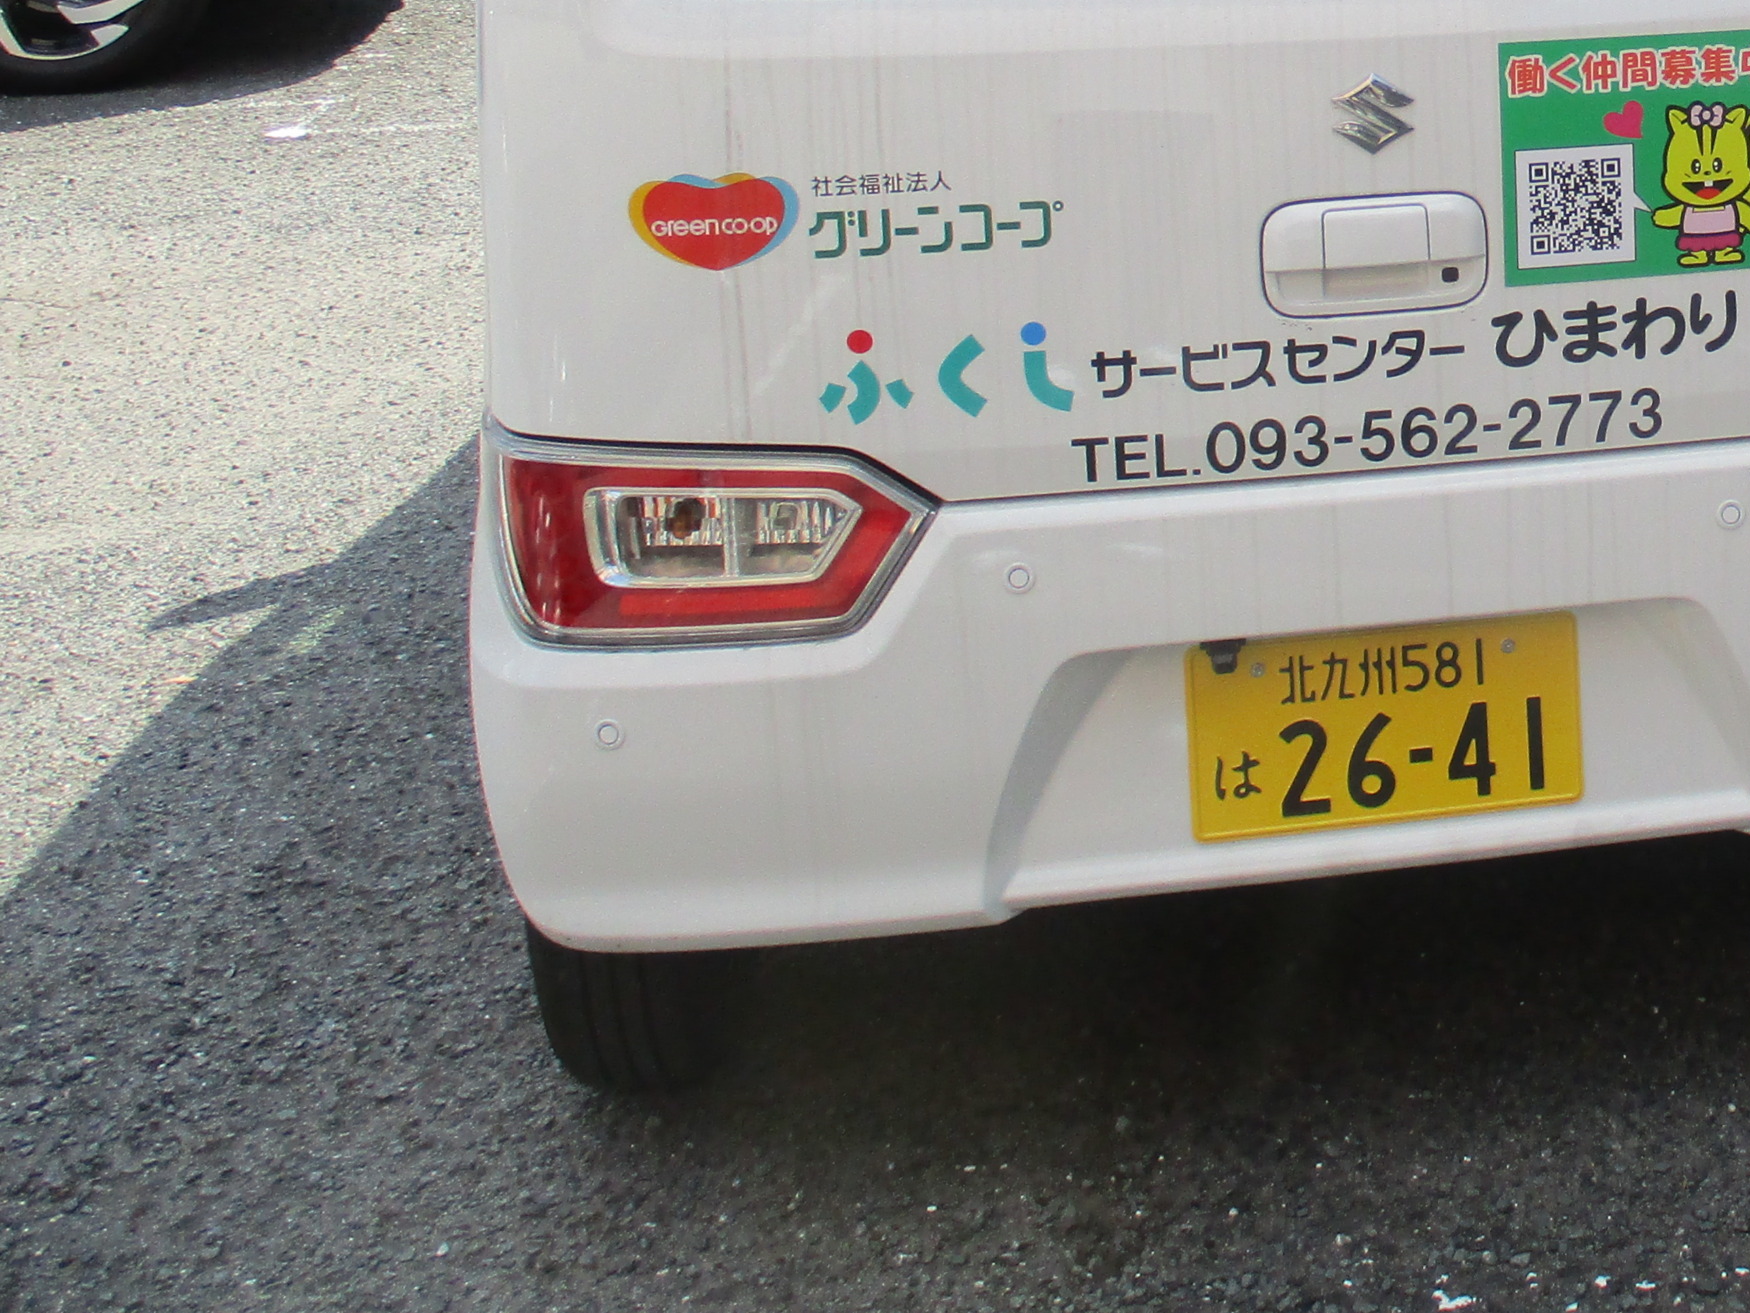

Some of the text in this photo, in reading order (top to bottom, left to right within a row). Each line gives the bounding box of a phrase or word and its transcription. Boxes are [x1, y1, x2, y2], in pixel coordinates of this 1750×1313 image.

[808, 199, 1065, 259] グリーンコープ
[811, 170, 952, 197] 社会福祉法人
[819, 289, 1738, 425] ふくし サービスセンター ひまわり
[1071, 387, 1663, 483] TEL.093-562-2773
[1215, 696, 1546, 818] は 26-41
